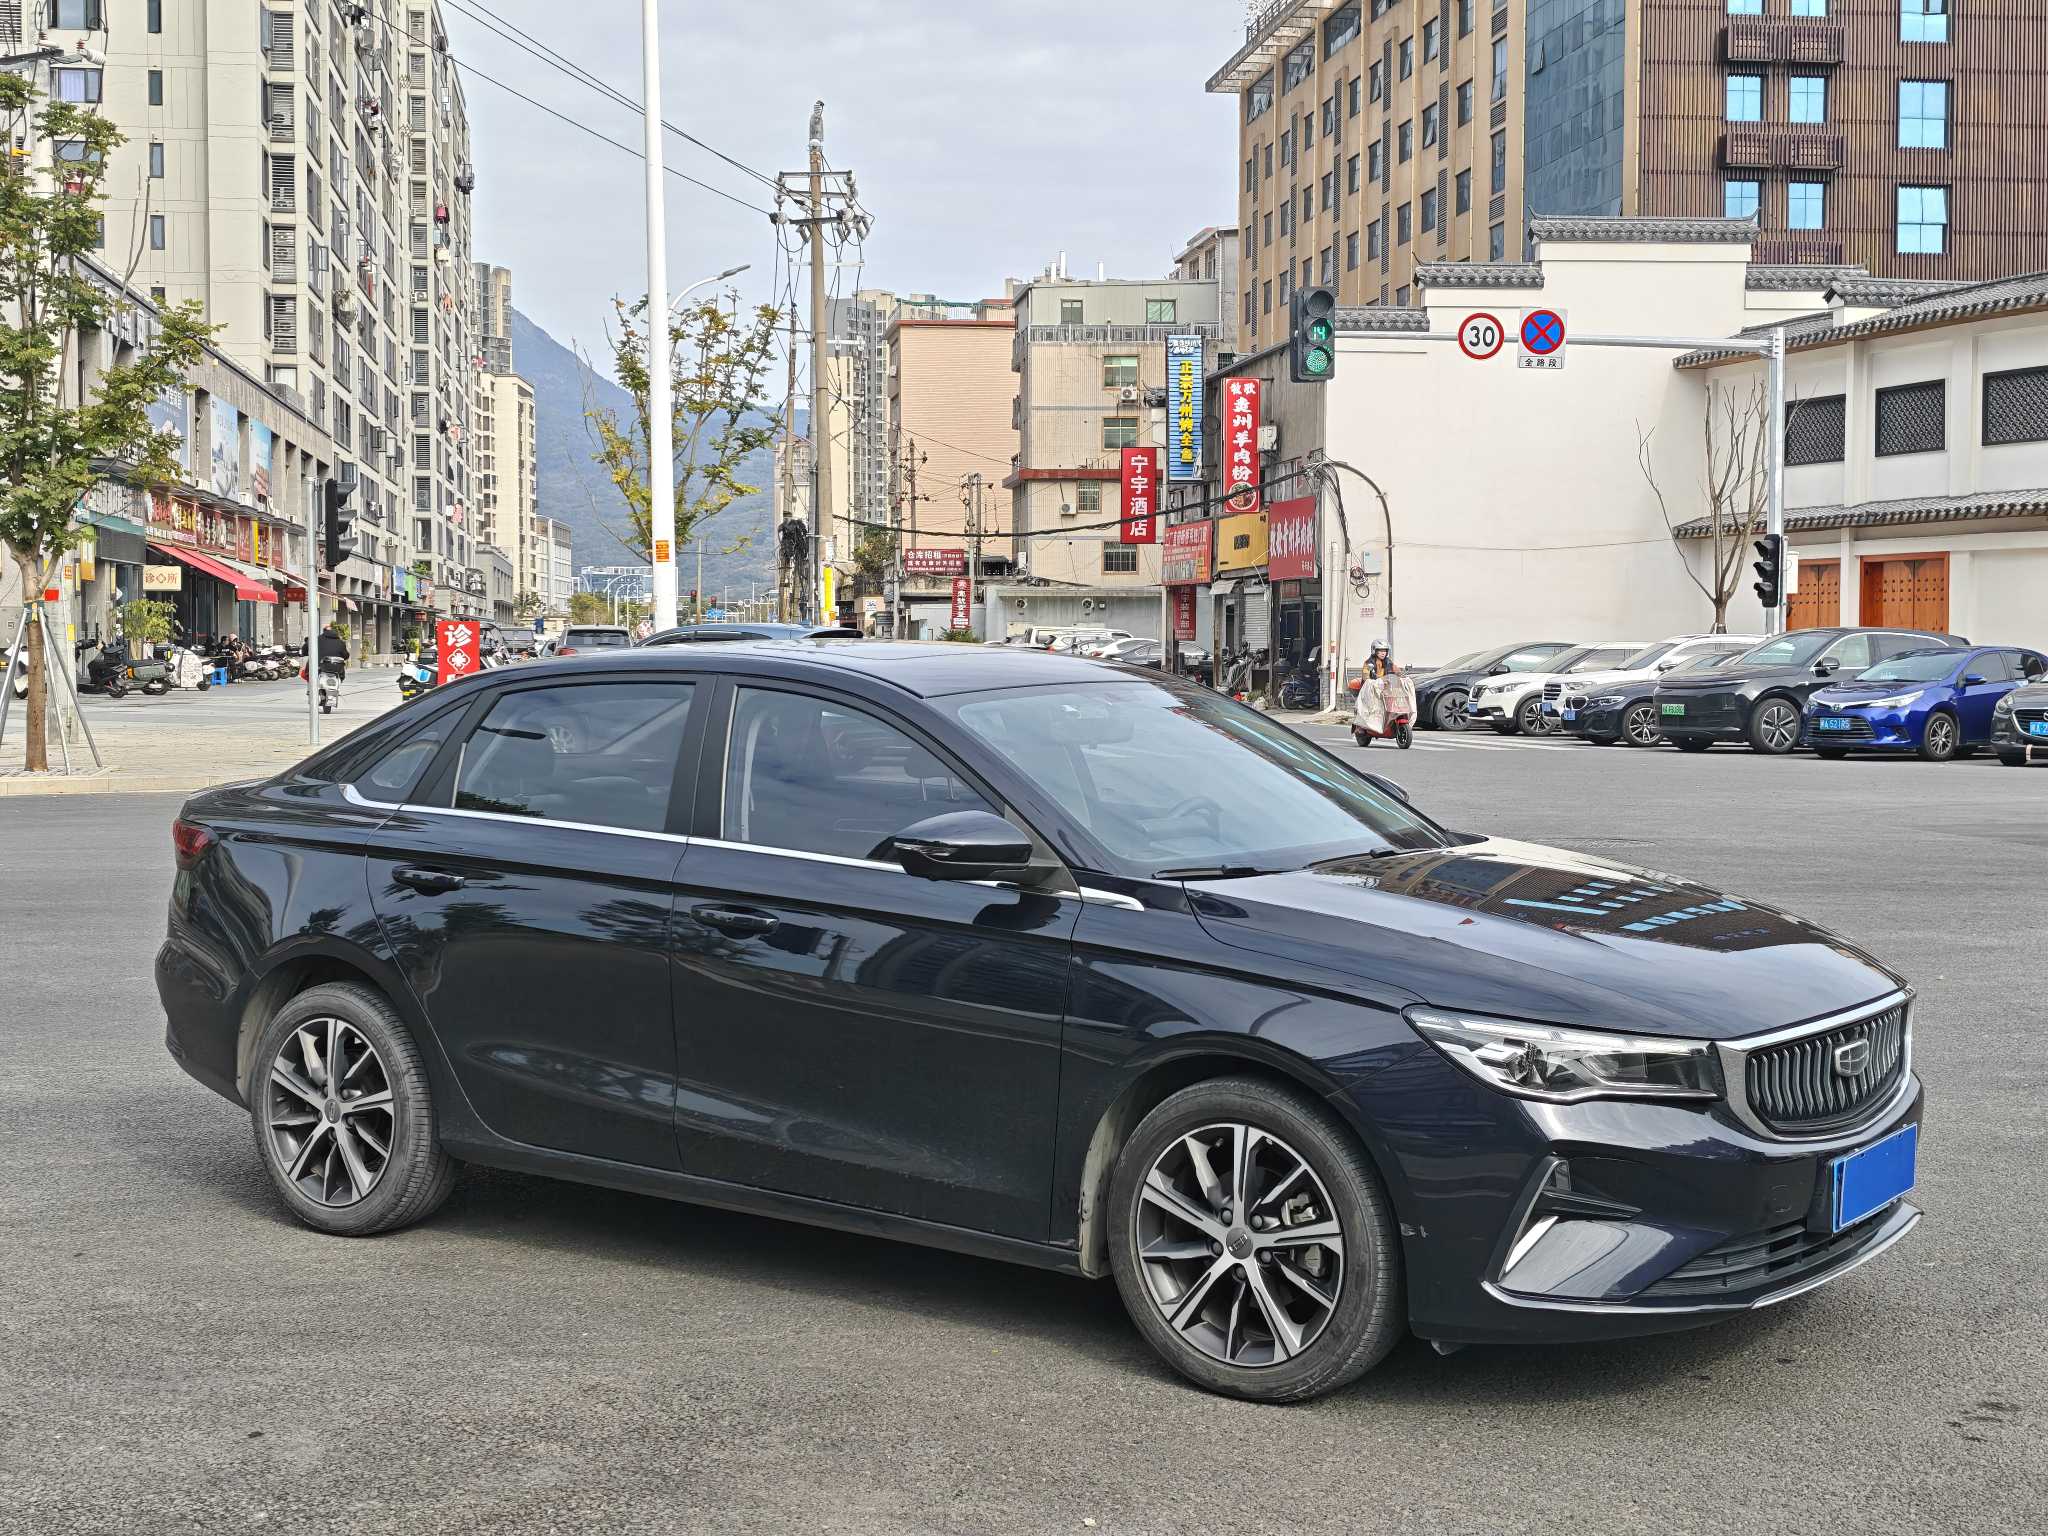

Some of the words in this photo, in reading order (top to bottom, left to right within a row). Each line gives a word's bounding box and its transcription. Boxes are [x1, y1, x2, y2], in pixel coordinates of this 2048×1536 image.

[1312, 326, 1326, 341] 14
[1469, 325, 1495, 347] 30
[1524, 358, 1557, 368] 全路段
[1232, 396, 1253, 481] 贵州羊肉粉
[1130, 454, 1148, 536] 宁宇酒店
[444, 624, 473, 649] 诊
